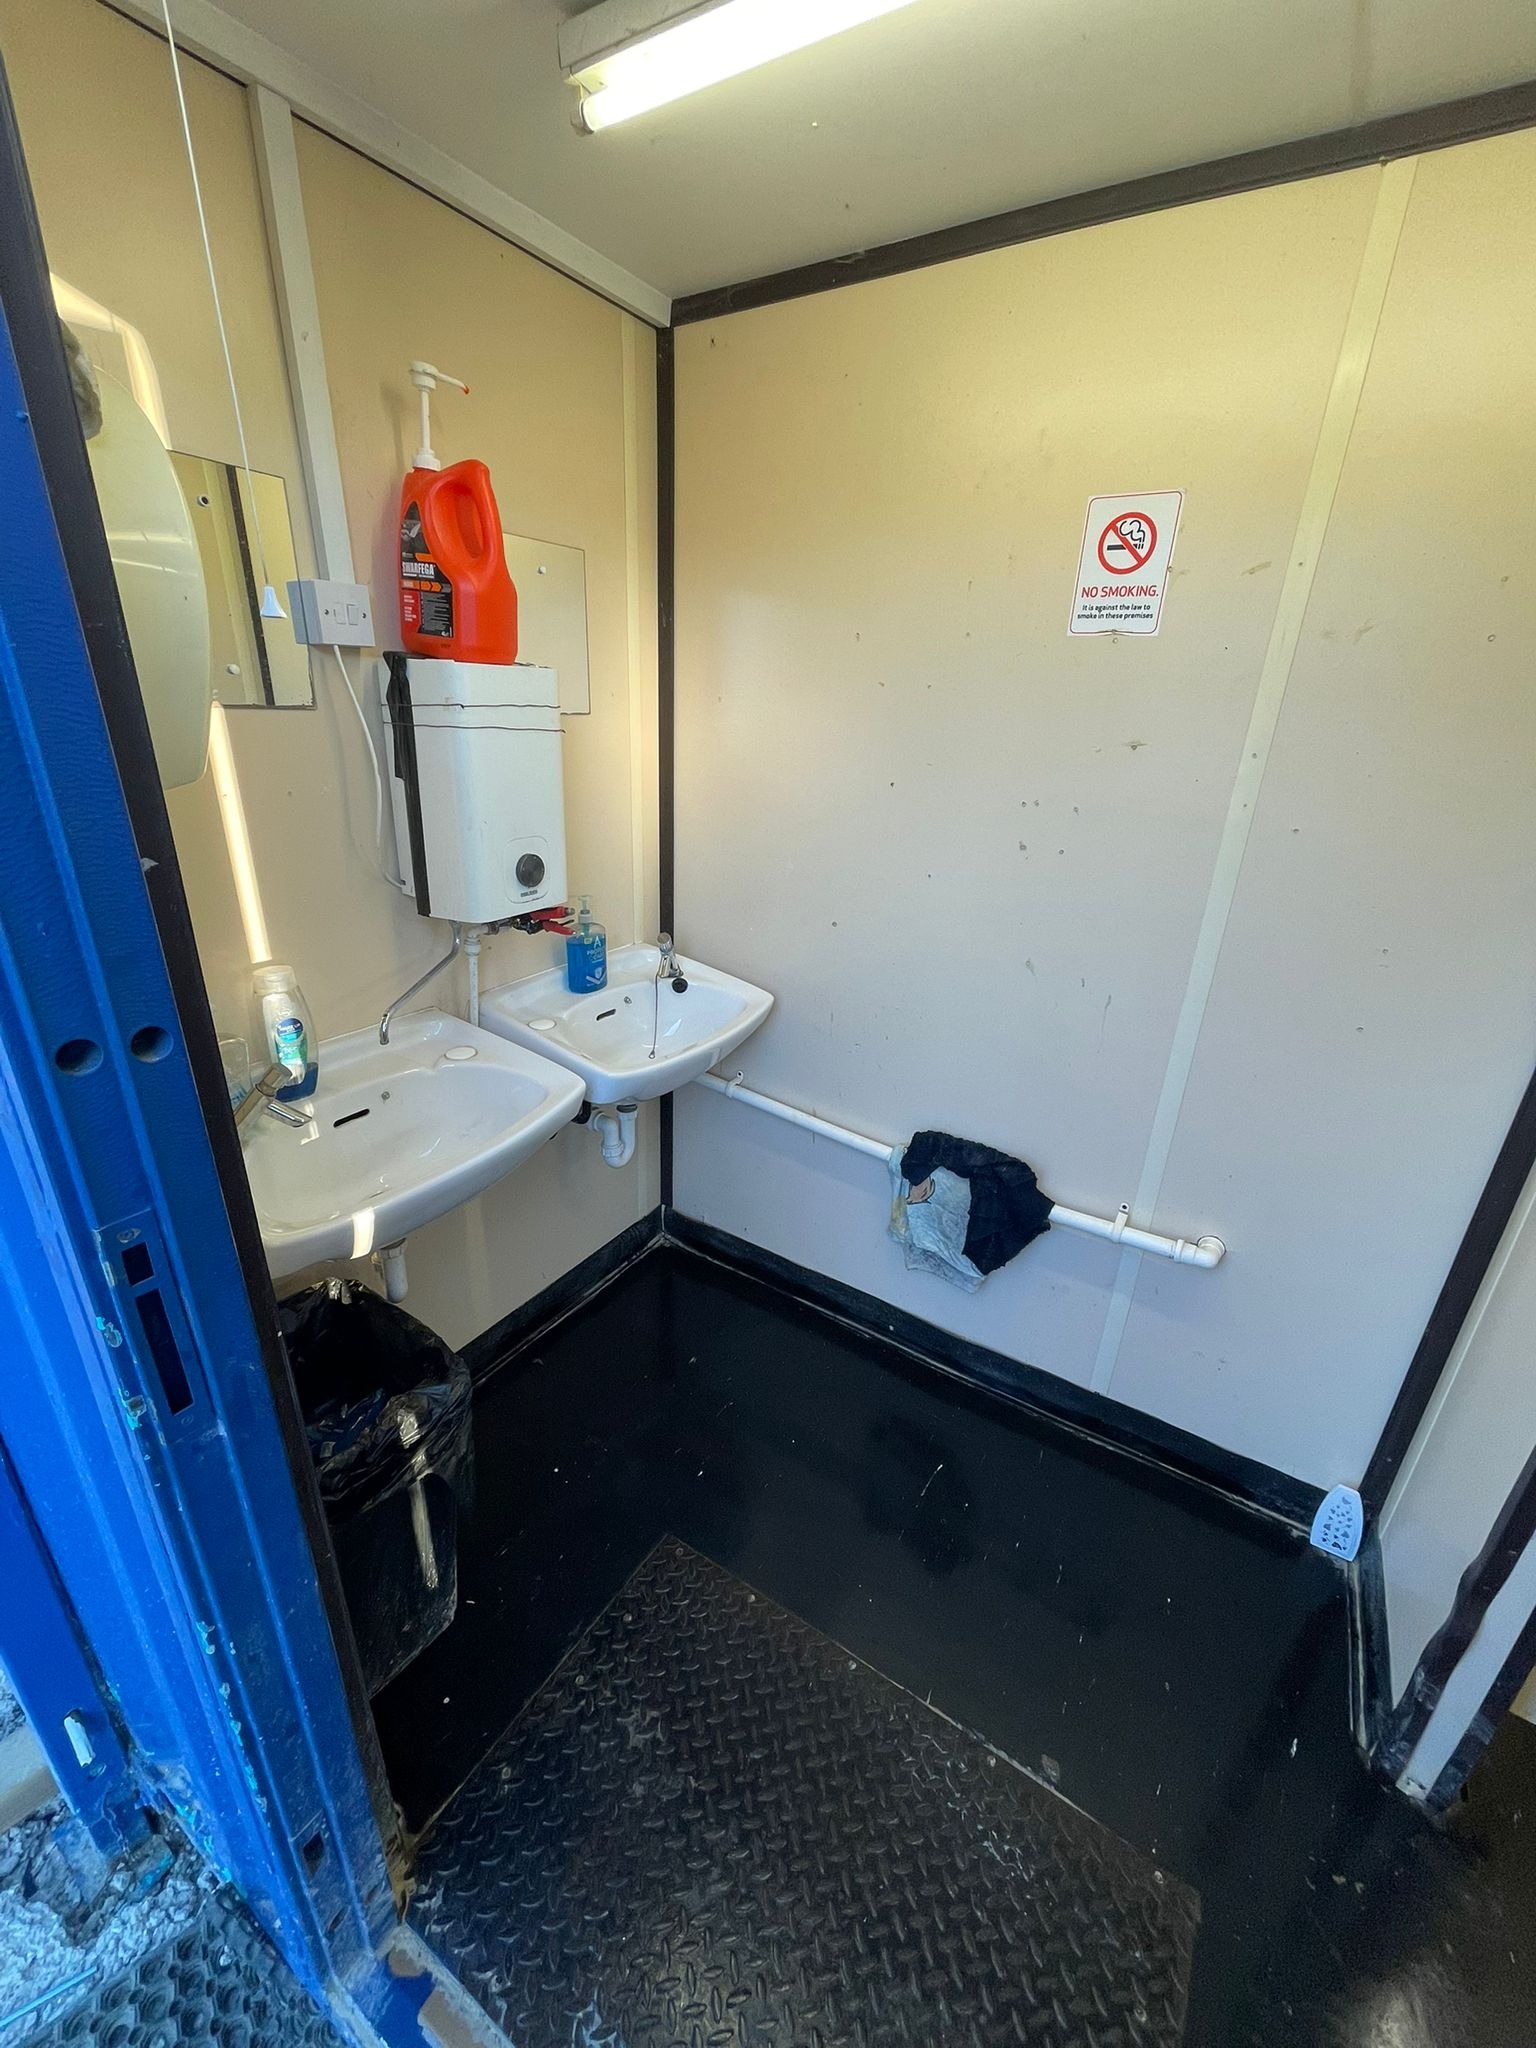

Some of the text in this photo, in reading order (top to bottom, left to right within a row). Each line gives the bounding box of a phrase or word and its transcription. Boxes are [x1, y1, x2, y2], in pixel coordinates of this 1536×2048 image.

[1081, 585, 1159, 598] NO SMOKING.
[1095, 604, 1118, 612] against
[1119, 603, 1130, 611] the
[1123, 612, 1153, 620] premises
